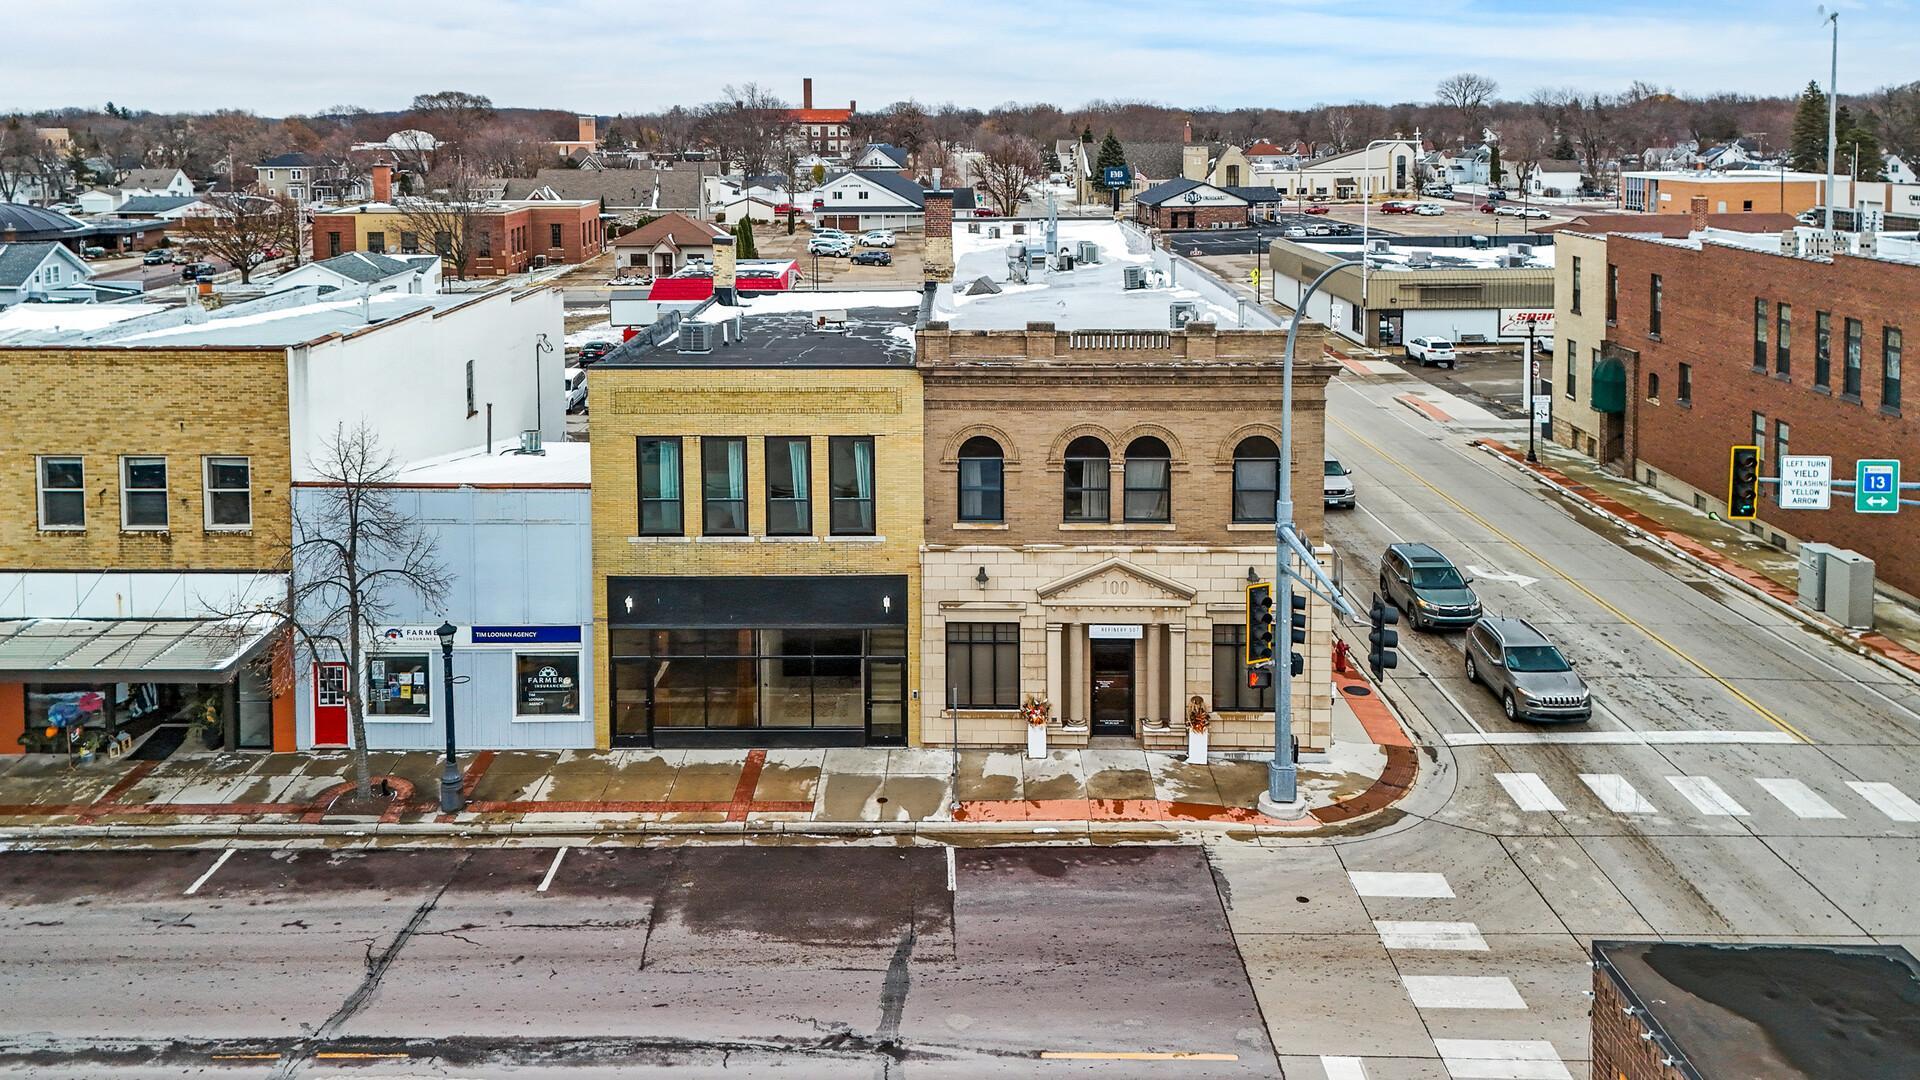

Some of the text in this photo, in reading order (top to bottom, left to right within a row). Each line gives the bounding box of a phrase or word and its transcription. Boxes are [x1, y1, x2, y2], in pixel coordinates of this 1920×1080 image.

[1793, 470, 1819, 478] YIELD
[1870, 476, 1886, 489] 13
[1101, 580, 1130, 595] 100
